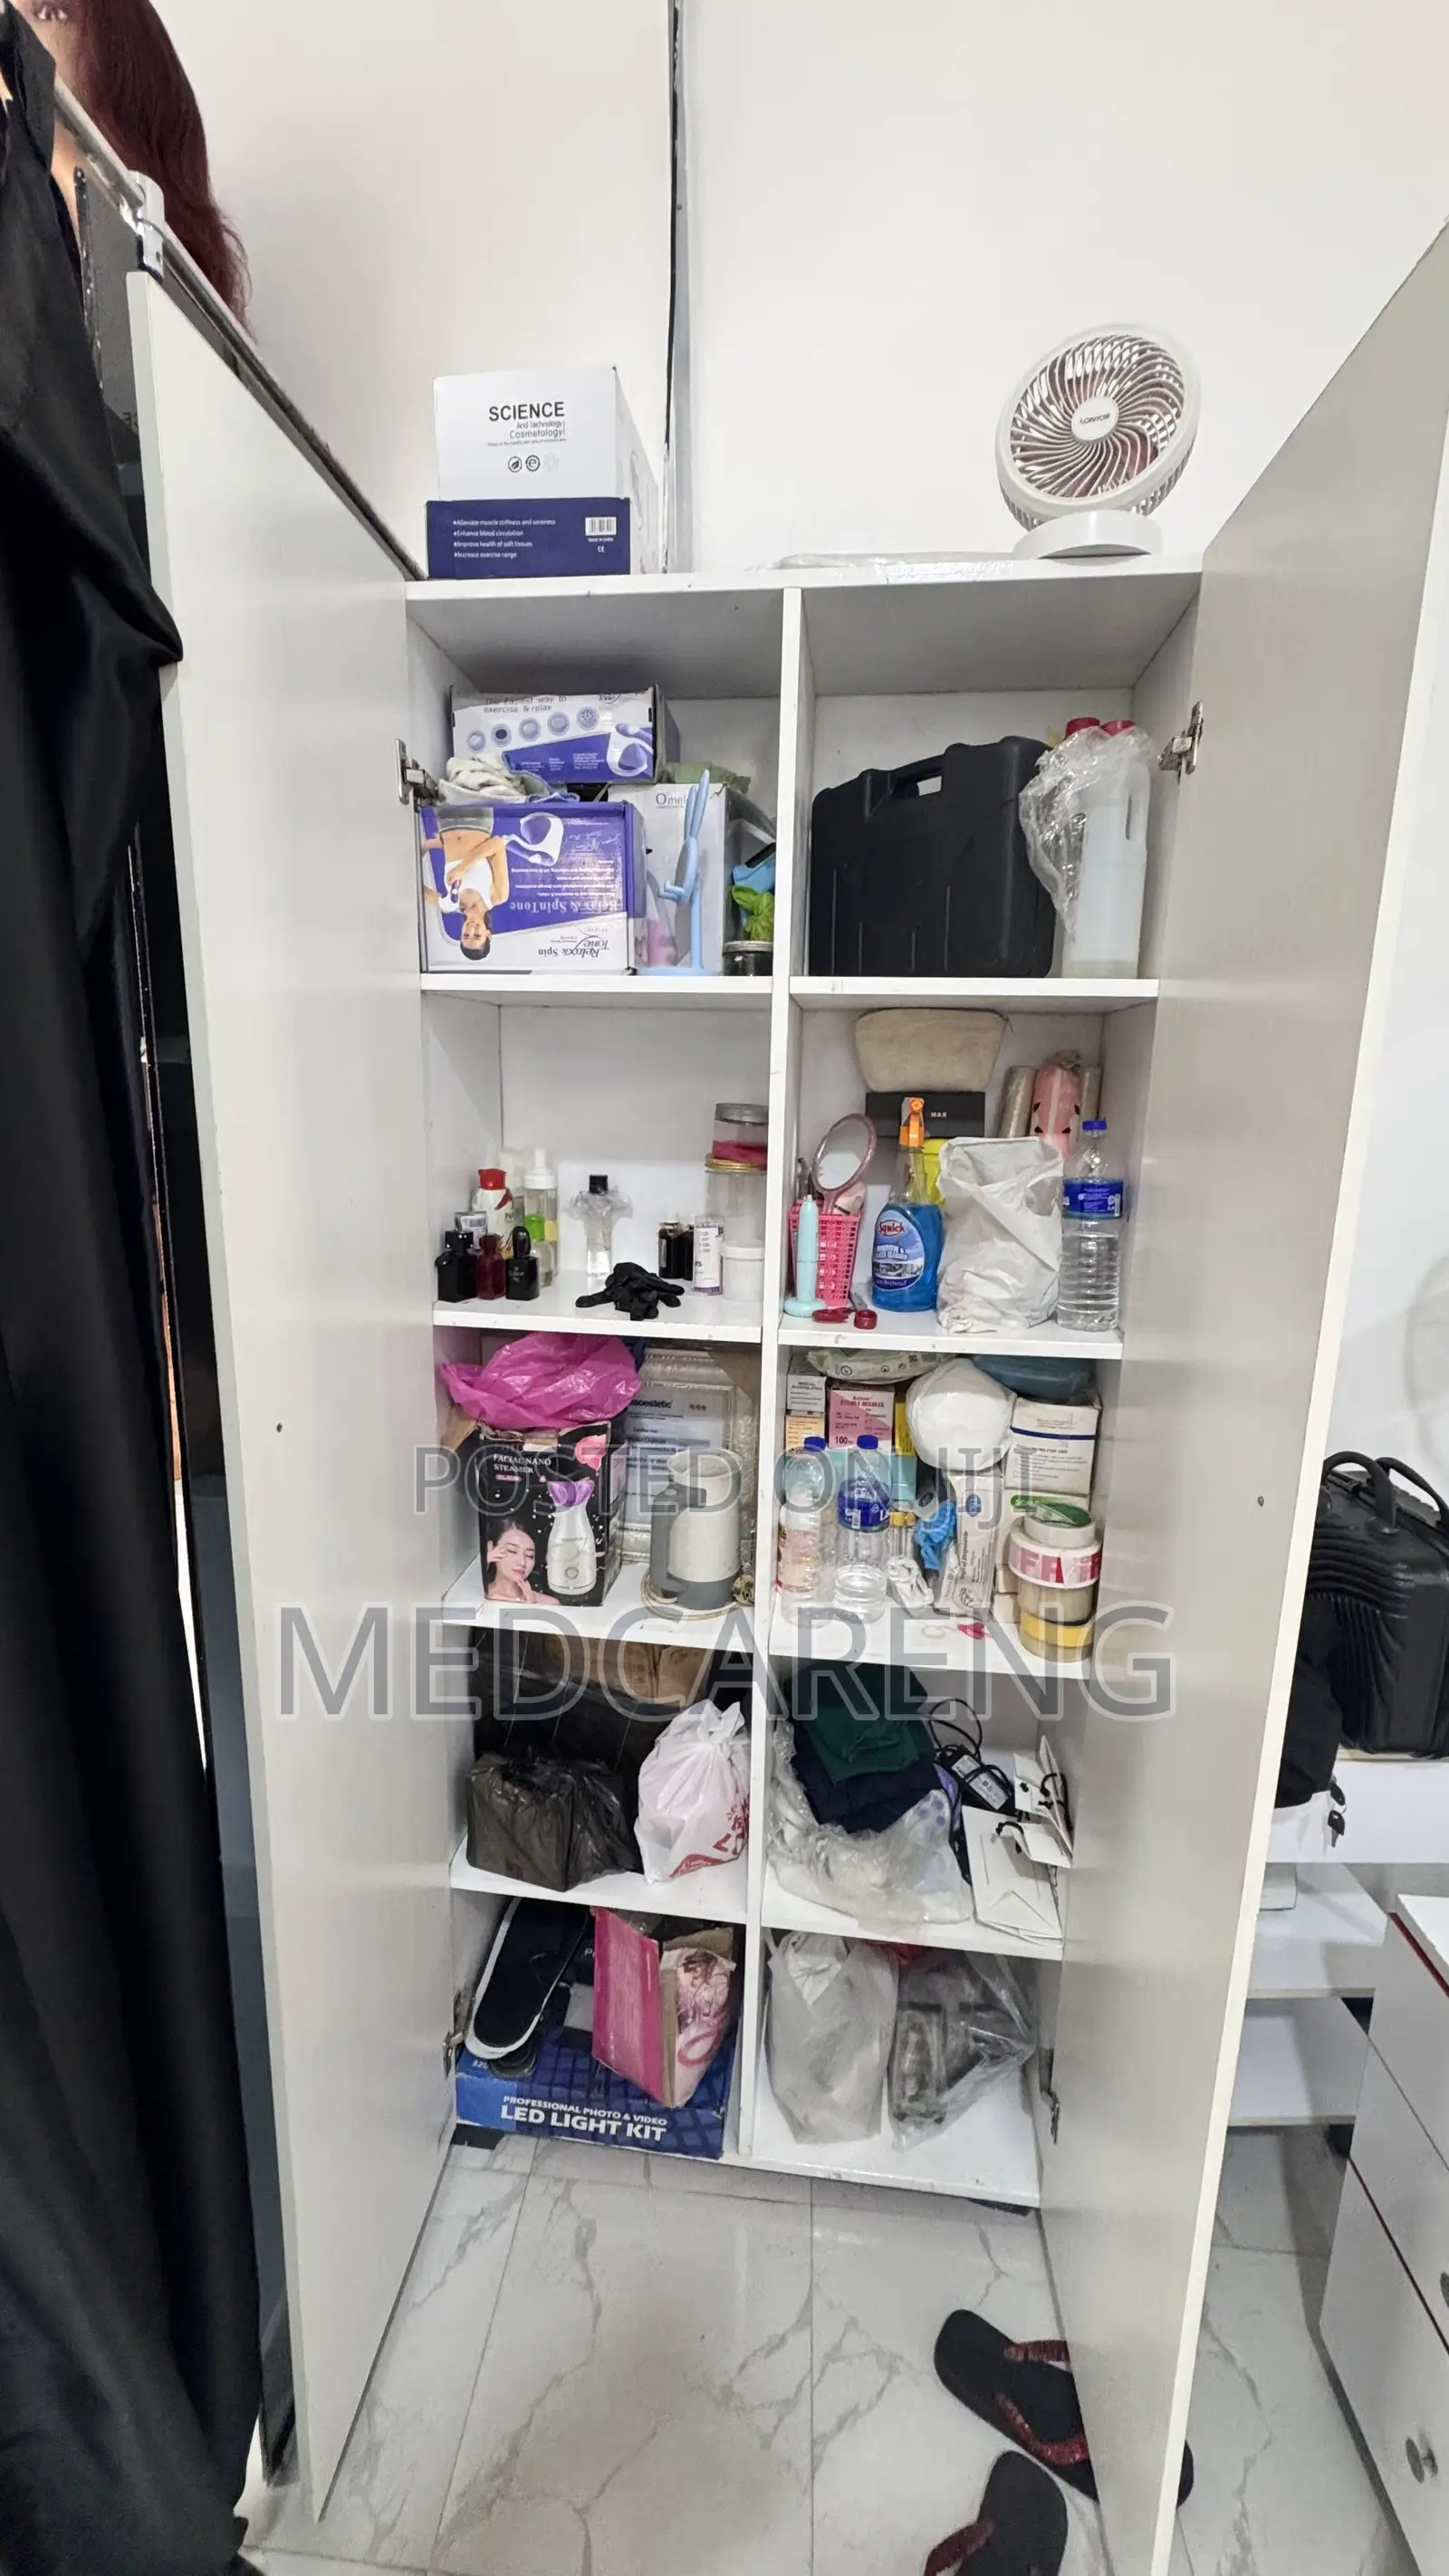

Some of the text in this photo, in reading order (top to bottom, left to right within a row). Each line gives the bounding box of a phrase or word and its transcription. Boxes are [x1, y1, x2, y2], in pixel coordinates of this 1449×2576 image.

[488, 401, 565, 422] SCIENCE
[530, 420, 562, 429] Technology
[1080, 413, 1110, 425] LONTOR
[509, 428, 563, 439] Cosmetology
[484, 704, 519, 713] exercise
[531, 704, 552, 712] relax
[582, 939, 609, 951] Tone
[538, 946, 559, 957] Spin
[834, 1435, 849, 1445] 100
[525, 1457, 552, 1466] NANO
[493, 1462, 534, 1474] STEAMER
[503, 2095, 668, 2126] PROFESSIONAL PHOTO & VIDEO
[500, 2104, 667, 2141] LED LIGHT KIT
